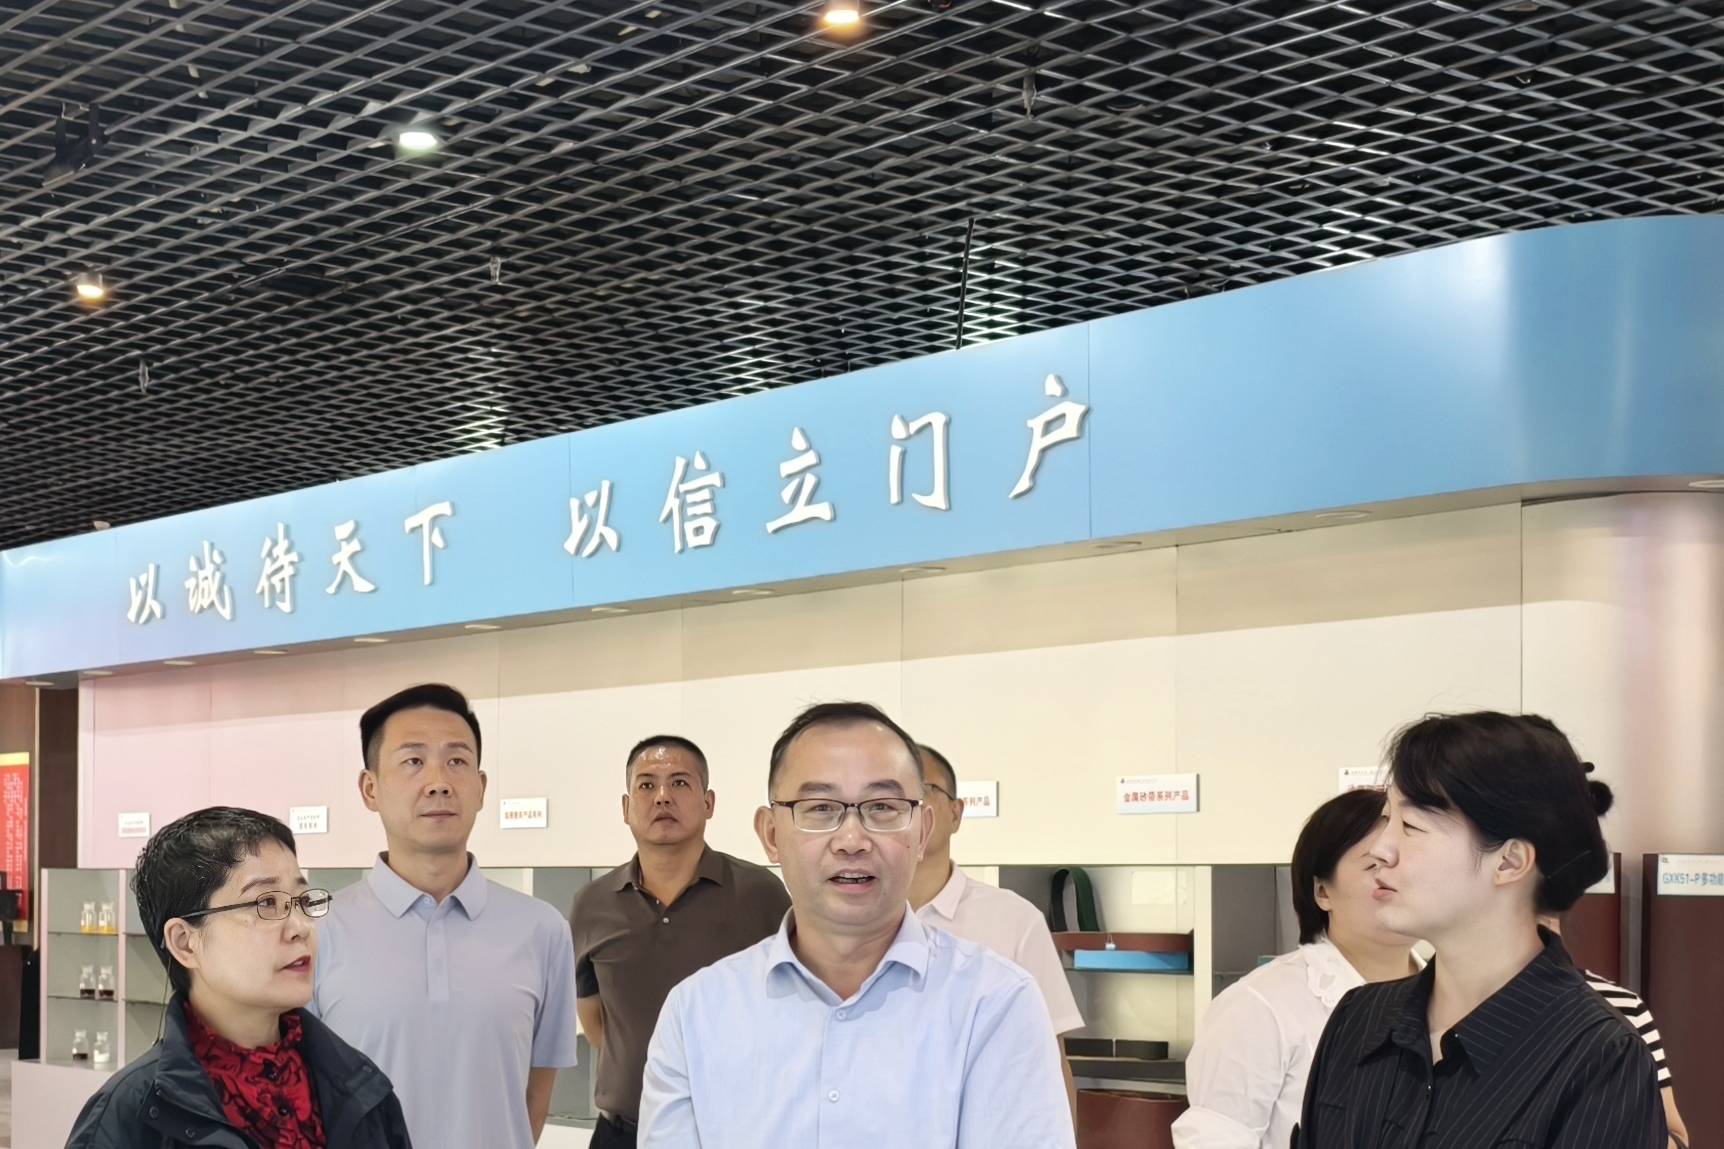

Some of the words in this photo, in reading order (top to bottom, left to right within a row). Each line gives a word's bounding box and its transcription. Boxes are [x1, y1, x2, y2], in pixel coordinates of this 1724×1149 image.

[126, 500, 455, 624] 以诚待天下
[563, 373, 1090, 557] 以信立门户
[1123, 789, 1190, 803] 金属砂带系列产品
